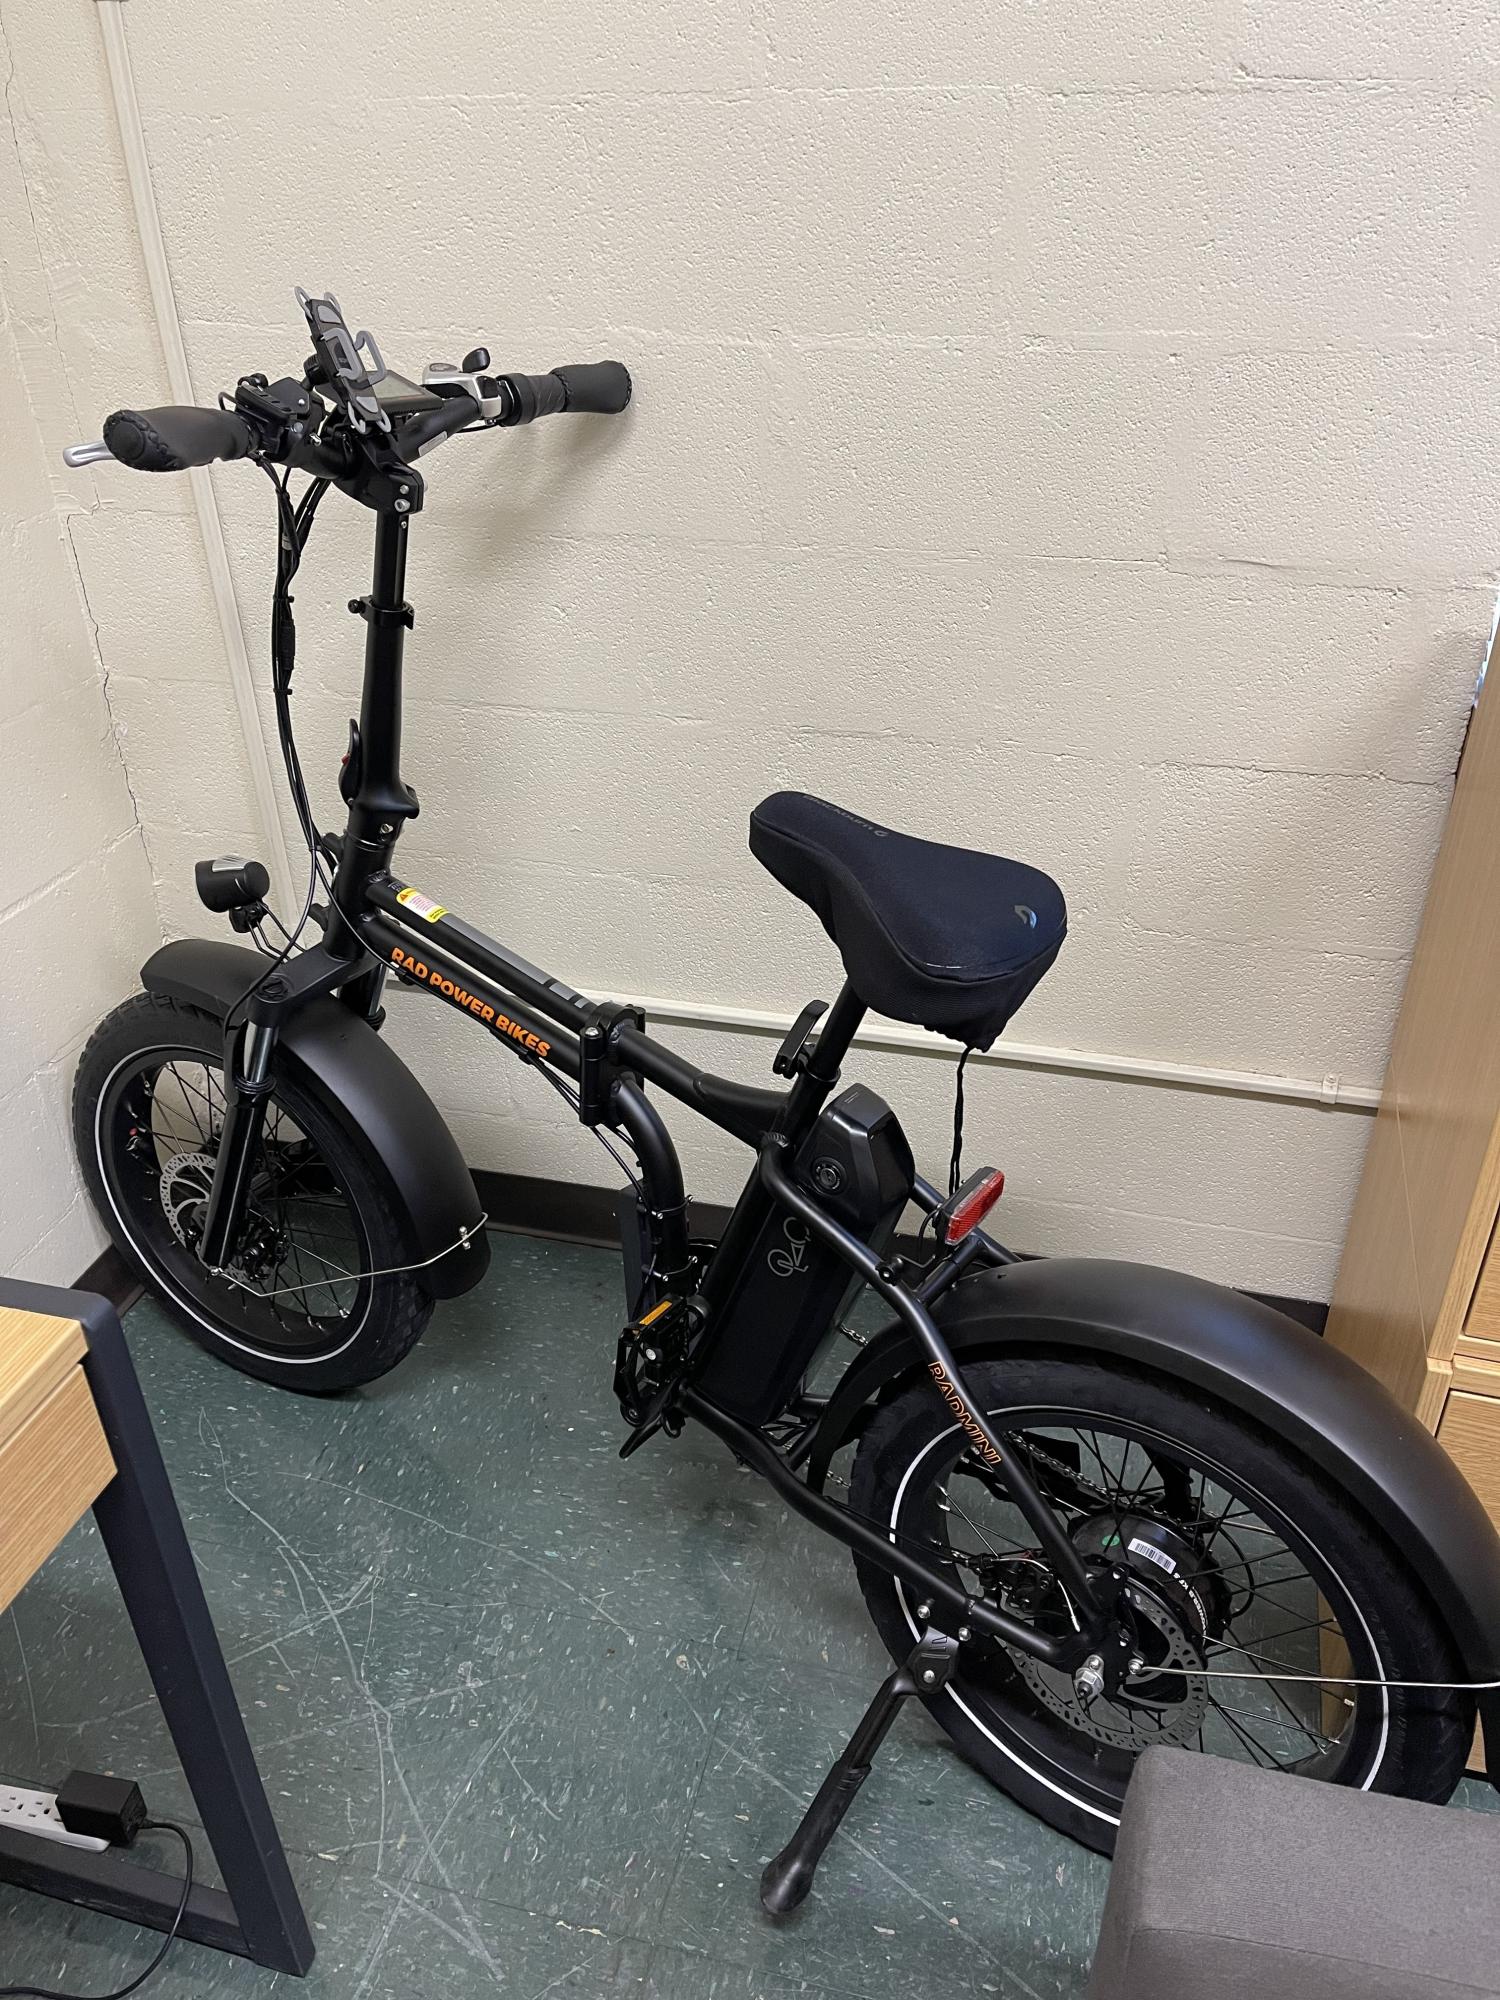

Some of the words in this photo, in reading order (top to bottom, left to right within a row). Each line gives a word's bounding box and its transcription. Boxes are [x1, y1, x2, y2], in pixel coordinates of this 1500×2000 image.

[391, 947, 428, 979] RAD
[429, 971, 495, 1022] POWER
[495, 1014, 550, 1057] BIKES
[928, 1361, 1001, 1464] RADMINI
